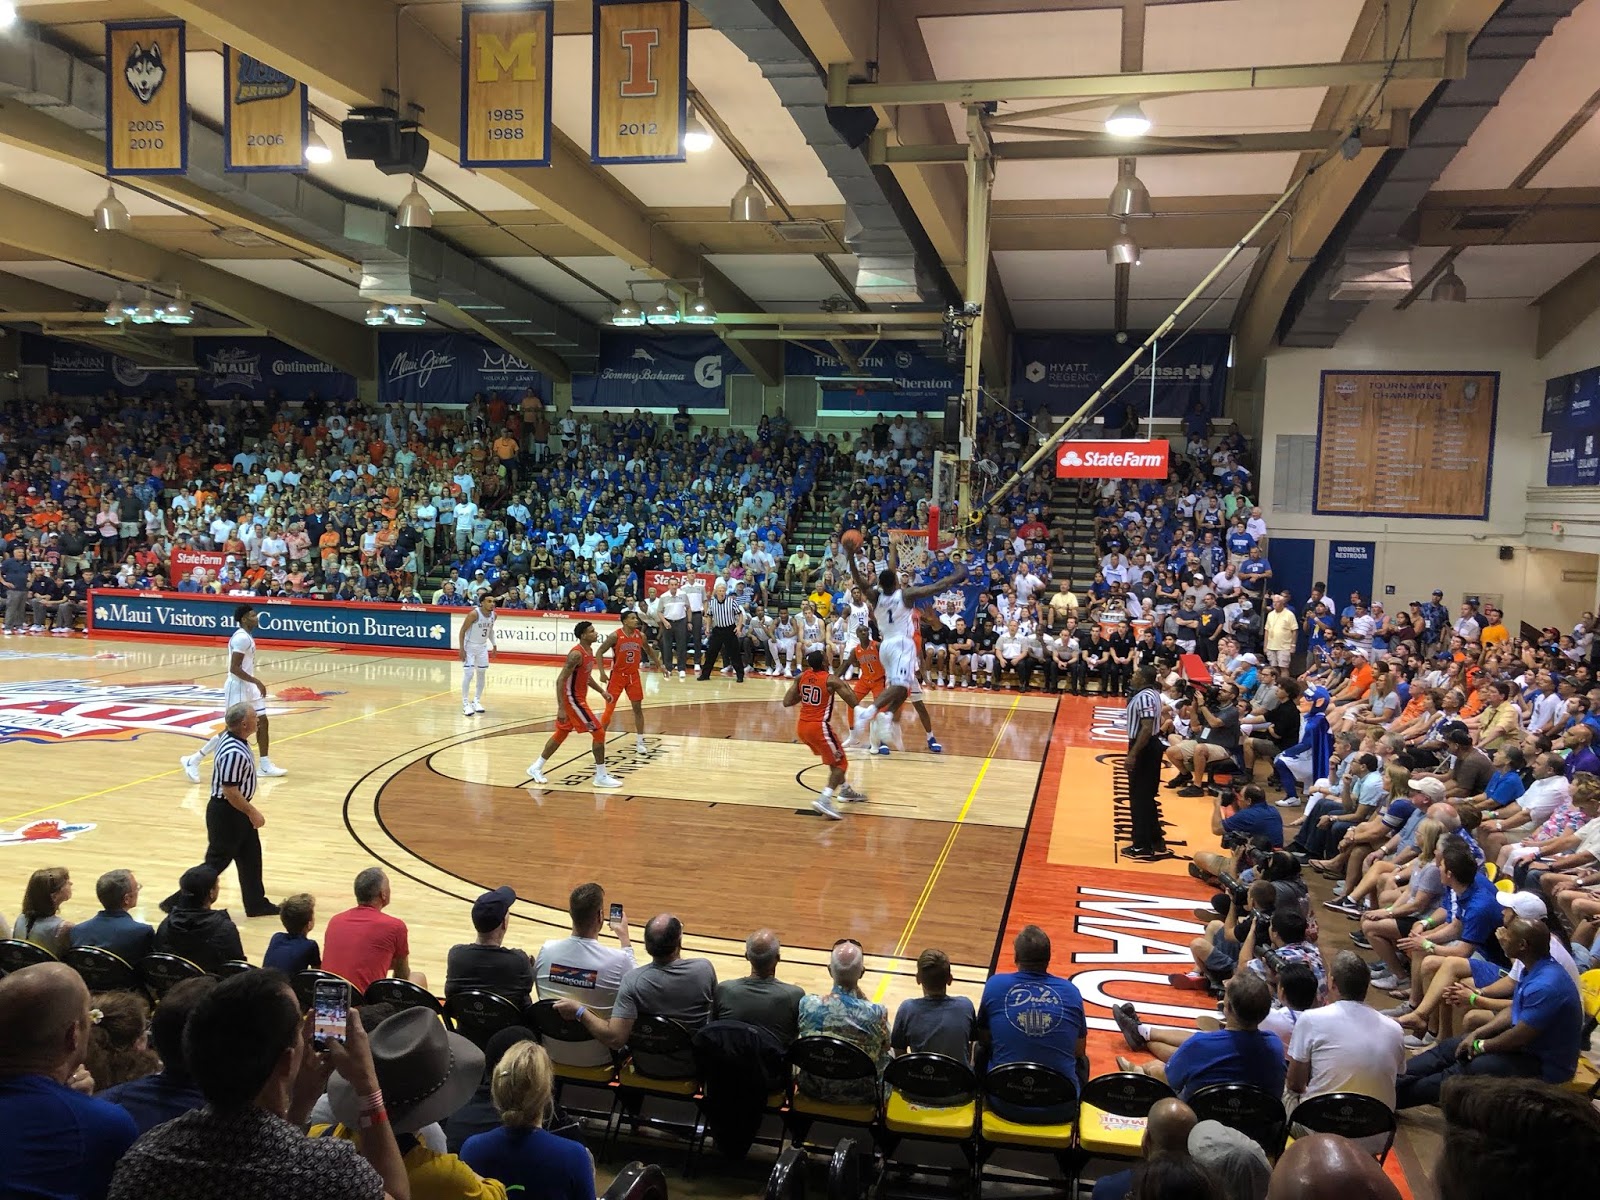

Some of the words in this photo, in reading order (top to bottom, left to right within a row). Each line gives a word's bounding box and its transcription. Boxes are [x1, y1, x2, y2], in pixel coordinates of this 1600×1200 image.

[476, 32, 537, 83] M
[620, 28, 659, 97] I
[487, 109, 524, 121] 1985
[128, 120, 165, 132] 2005
[619, 123, 658, 136] 2012
[247, 134, 285, 146] 2006
[487, 128, 524, 140] 1988
[130, 138, 164, 150] 2010
[213, 361, 255, 374] MAUI
[272, 360, 334, 375] Continental
[482, 349, 533, 373] MAU
[1049, 363, 1089, 372] HYATT
[389, 350, 421, 376] Maui
[420, 350, 456, 388] Jim
[694, 355, 722, 388] G
[601, 368, 641, 384] Tommy
[640, 368, 686, 380] Bahama
[1049, 372, 1100, 381] REGENCY
[894, 377, 953, 389] Sheraton
[1369, 382, 1450, 391] TOURNAMENT
[1372, 391, 1442, 400] CHAMPIONS
[177, 552, 221, 565] StateFarm
[110, 603, 152, 623] Maui
[154, 606, 216, 628] Visitors
[256, 611, 360, 635] Convention
[363, 617, 428, 639] Bureau
[858, 617, 865, 626] 5
[887, 609, 895, 624] 1
[481, 628, 488, 638] 3
[625, 651, 635, 664] 2
[867, 662, 874, 673] 1
[802, 684, 822, 706] 50
[1068, 885, 1226, 1037] MAUI
[549, 974, 595, 987] patagonia
